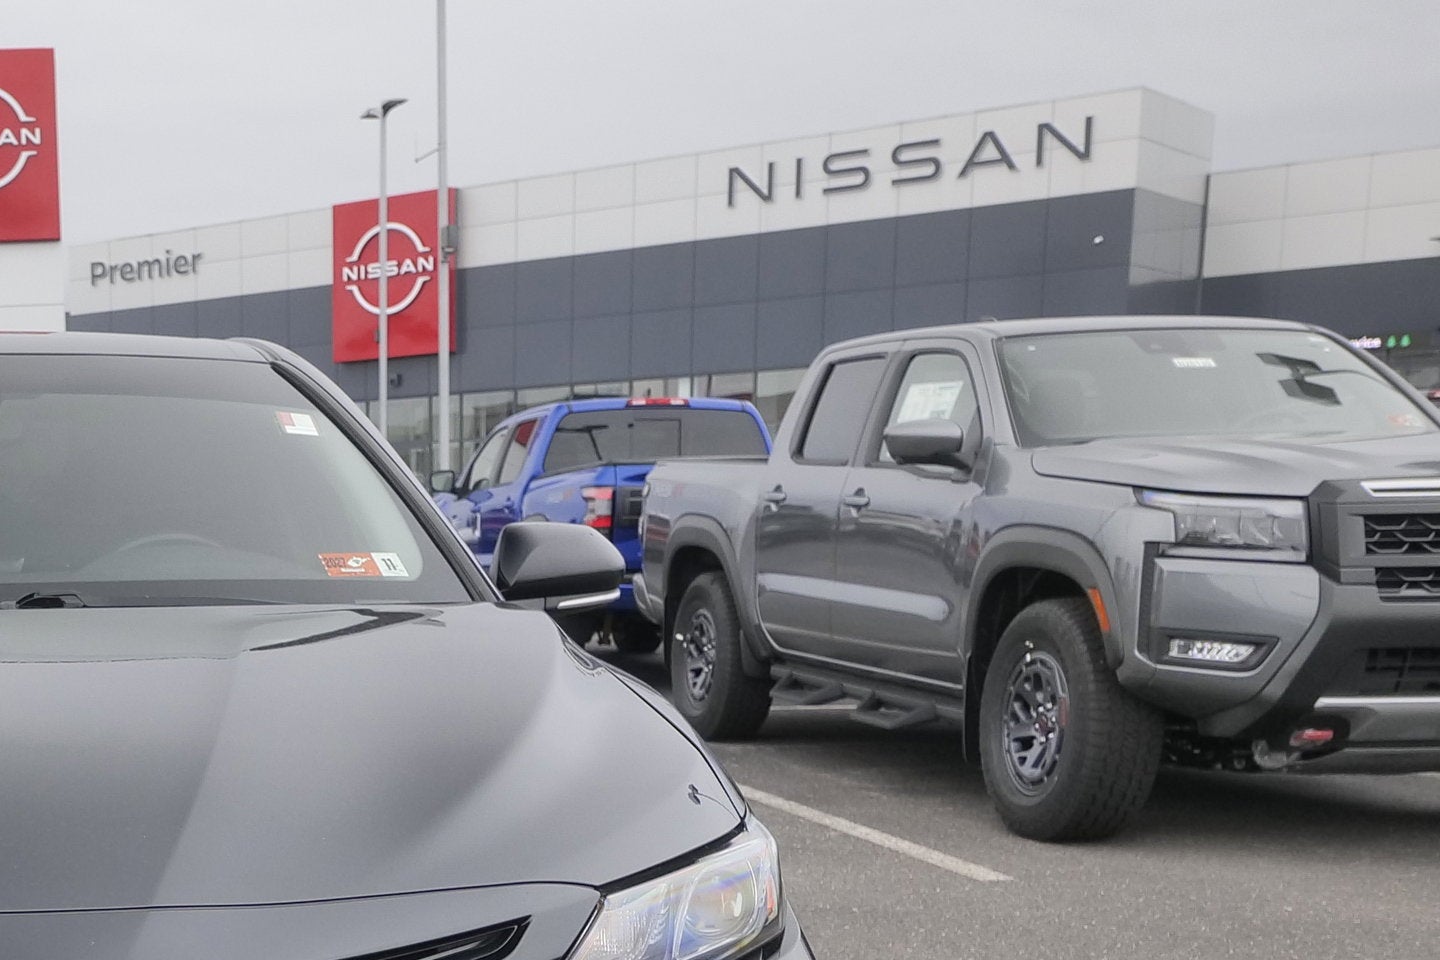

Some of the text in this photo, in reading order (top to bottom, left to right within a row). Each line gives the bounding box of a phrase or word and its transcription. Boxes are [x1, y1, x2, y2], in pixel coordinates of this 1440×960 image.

[727, 115, 1094, 208] NISSAN
[90, 249, 203, 287] Premier
[342, 255, 434, 282] NISSAN
